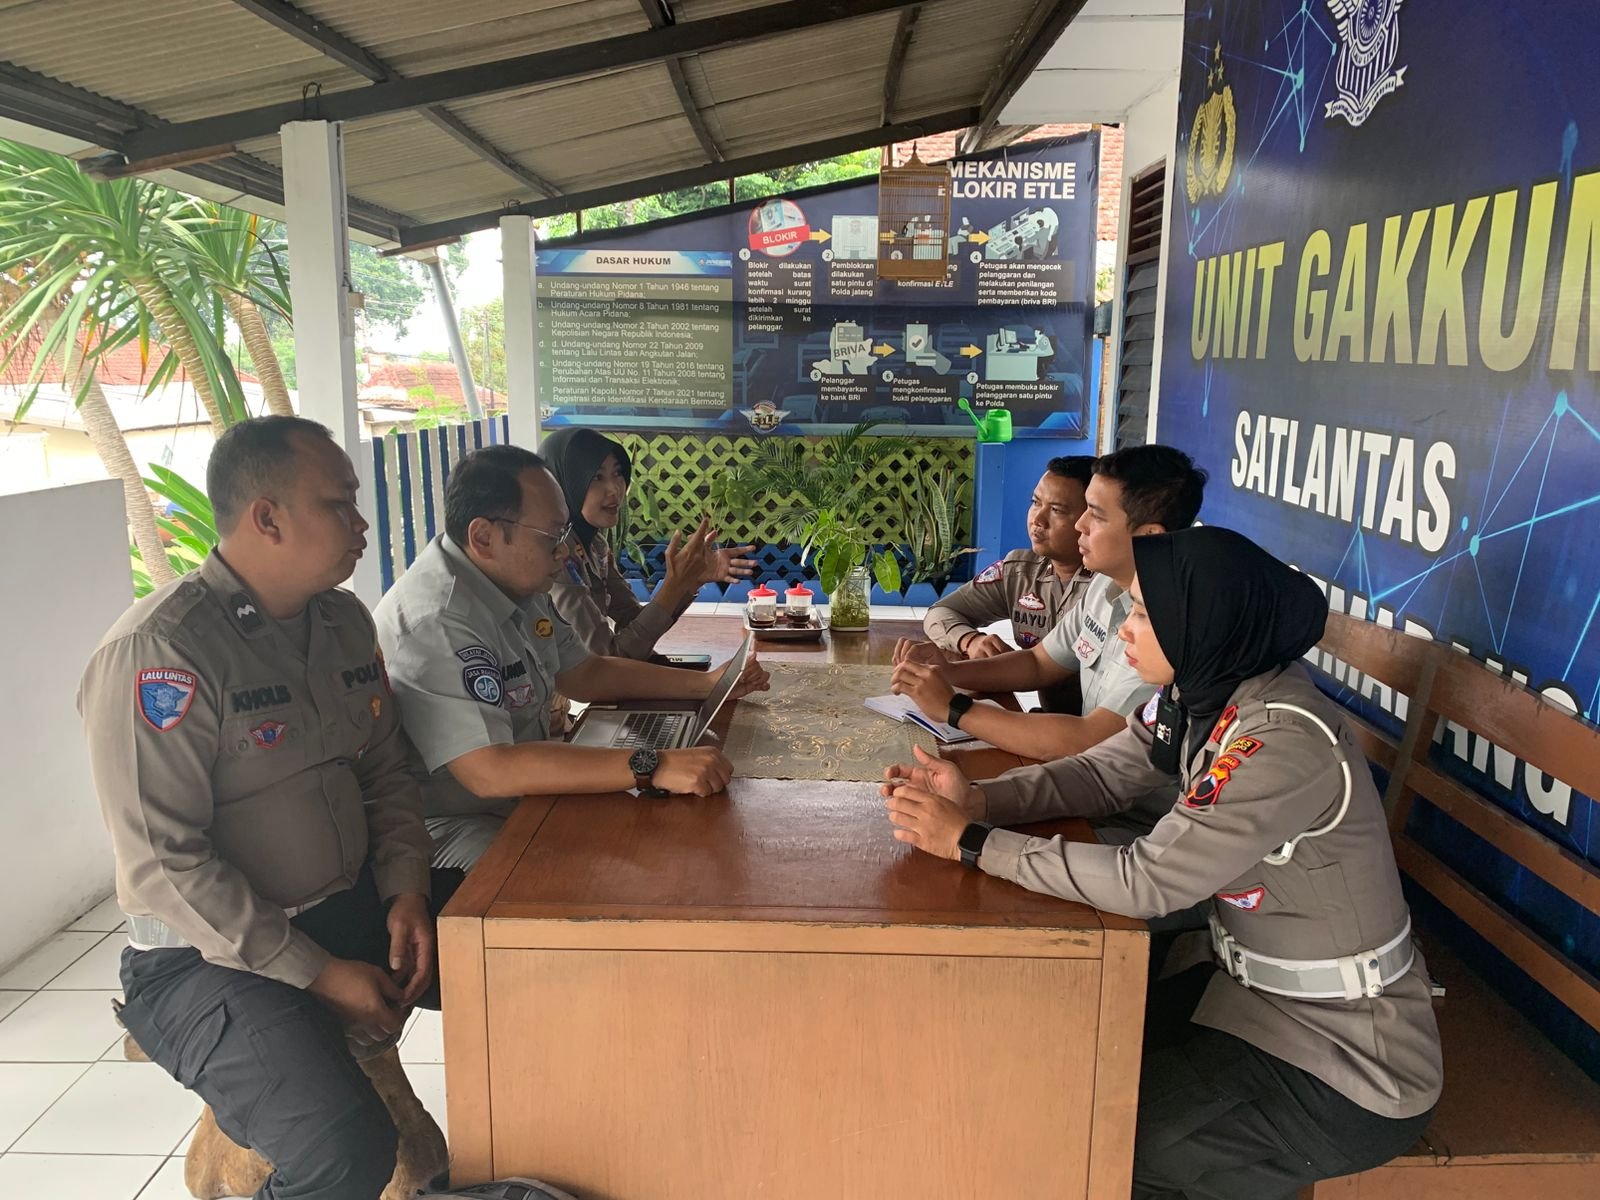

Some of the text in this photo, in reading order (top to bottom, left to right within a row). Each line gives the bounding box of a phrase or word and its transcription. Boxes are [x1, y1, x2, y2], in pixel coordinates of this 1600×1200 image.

[946, 161, 1076, 179] MEKANISME
[1023, 182, 1076, 199] ETLE
[762, 231, 798, 245] BLOKIR
[596, 256, 672, 265] DASAR HUKUM
[979, 262, 1007, 270] Petugas
[1027, 263, 1062, 271] mengecek
[550, 282, 610, 291] Undang-undang
[612, 282, 637, 290] Nomor
[646, 283, 669, 291] Tahun
[691, 283, 719, 293] tentang
[847, 280, 865, 288] pintu
[551, 290, 587, 298] Peraturan
[589, 290, 615, 298] Hukum
[787, 289, 812, 297] kurang
[852, 289, 873, 297] jateng
[1042, 298, 1057, 306] BRI)
[1191, 241, 1285, 360] UNIT
[551, 301, 611, 311] Undang-undang
[612, 302, 637, 310] Nomor
[646, 302, 669, 310] Tahun
[691, 303, 719, 313] tentang
[551, 309, 578, 317] Hukum
[551, 321, 611, 330] Undang-undang
[612, 321, 638, 329] Nomor
[646, 322, 669, 330] Tahun
[691, 323, 719, 332] tentang
[552, 329, 590, 338] Kepolisian
[592, 329, 619, 338] Negara
[621, 330, 653, 338] Republik
[561, 341, 620, 350] Undang-undang
[622, 341, 648, 349] Nomor
[552, 349, 580, 358] tentang
[600, 349, 621, 357] Lintas
[639, 350, 674, 359] Angkutan
[833, 344, 866, 358] BRIVA
[552, 360, 611, 369] Undang-undang
[614, 360, 638, 368] Nomor
[651, 361, 674, 369] Tahun
[697, 362, 724, 372] tentang
[552, 368, 593, 376] Perubahan
[594, 368, 611, 376] Atas
[653, 369, 676, 377] Tahun
[698, 370, 725, 379] tentang
[553, 376, 588, 384] Informasi
[605, 377, 640, 385] Transaksi
[821, 377, 855, 385] Pelanggar
[553, 387, 589, 395] Peraturan
[619, 388, 643, 396] Nomor
[652, 388, 675, 396] Tahun
[697, 390, 724, 399] tentang
[821, 386, 868, 394] membayarkan
[553, 395, 589, 404] Registrasi
[591, 395, 606, 403] dan
[608, 395, 646, 404] Identifikasi
[648, 396, 689, 405] Kendaraan
[1035, 392, 1052, 400] pintu
[1231, 410, 1456, 553] SATLANTAS
[1013, 610, 1047, 629] BAYU
[141, 671, 193, 685] LALU LINTAS
